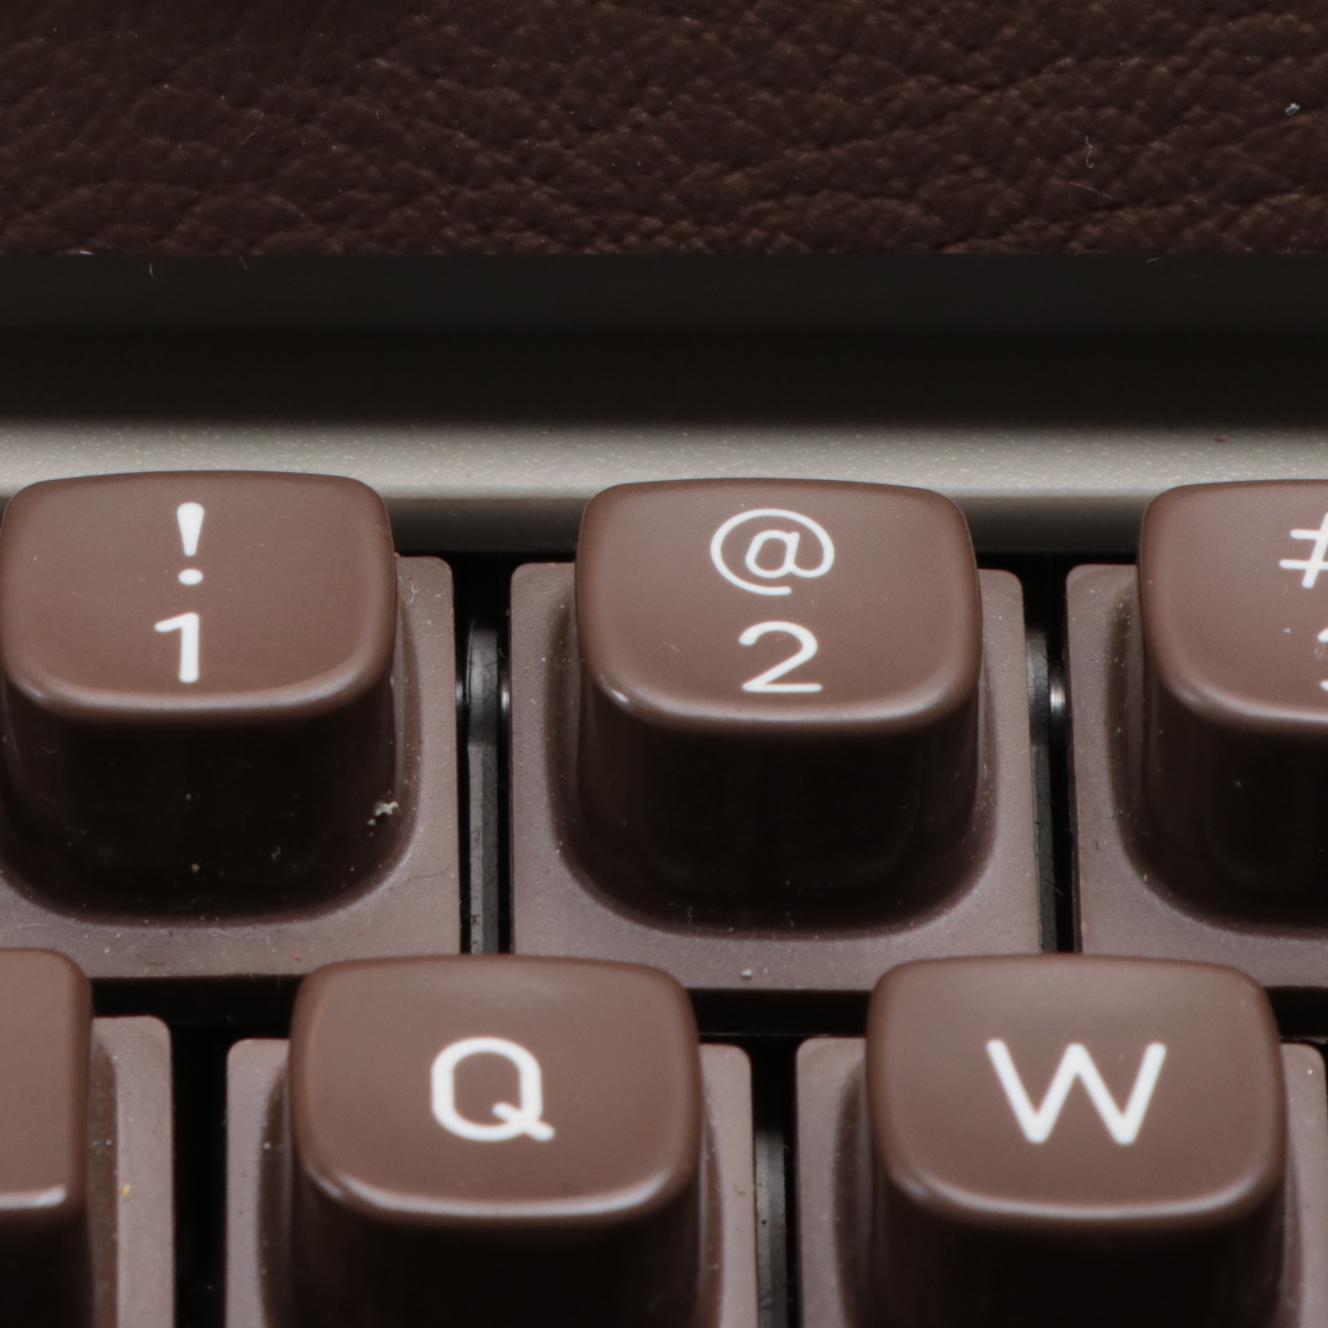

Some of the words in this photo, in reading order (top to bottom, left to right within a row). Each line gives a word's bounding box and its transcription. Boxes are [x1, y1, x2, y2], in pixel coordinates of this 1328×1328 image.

[175, 501, 206, 587] !
[708, 507, 837, 596] @
[153, 612, 201, 684] 1
[737, 620, 823, 694] 2
[429, 1036, 556, 1143] Q
[985, 1038, 1168, 1146] W
